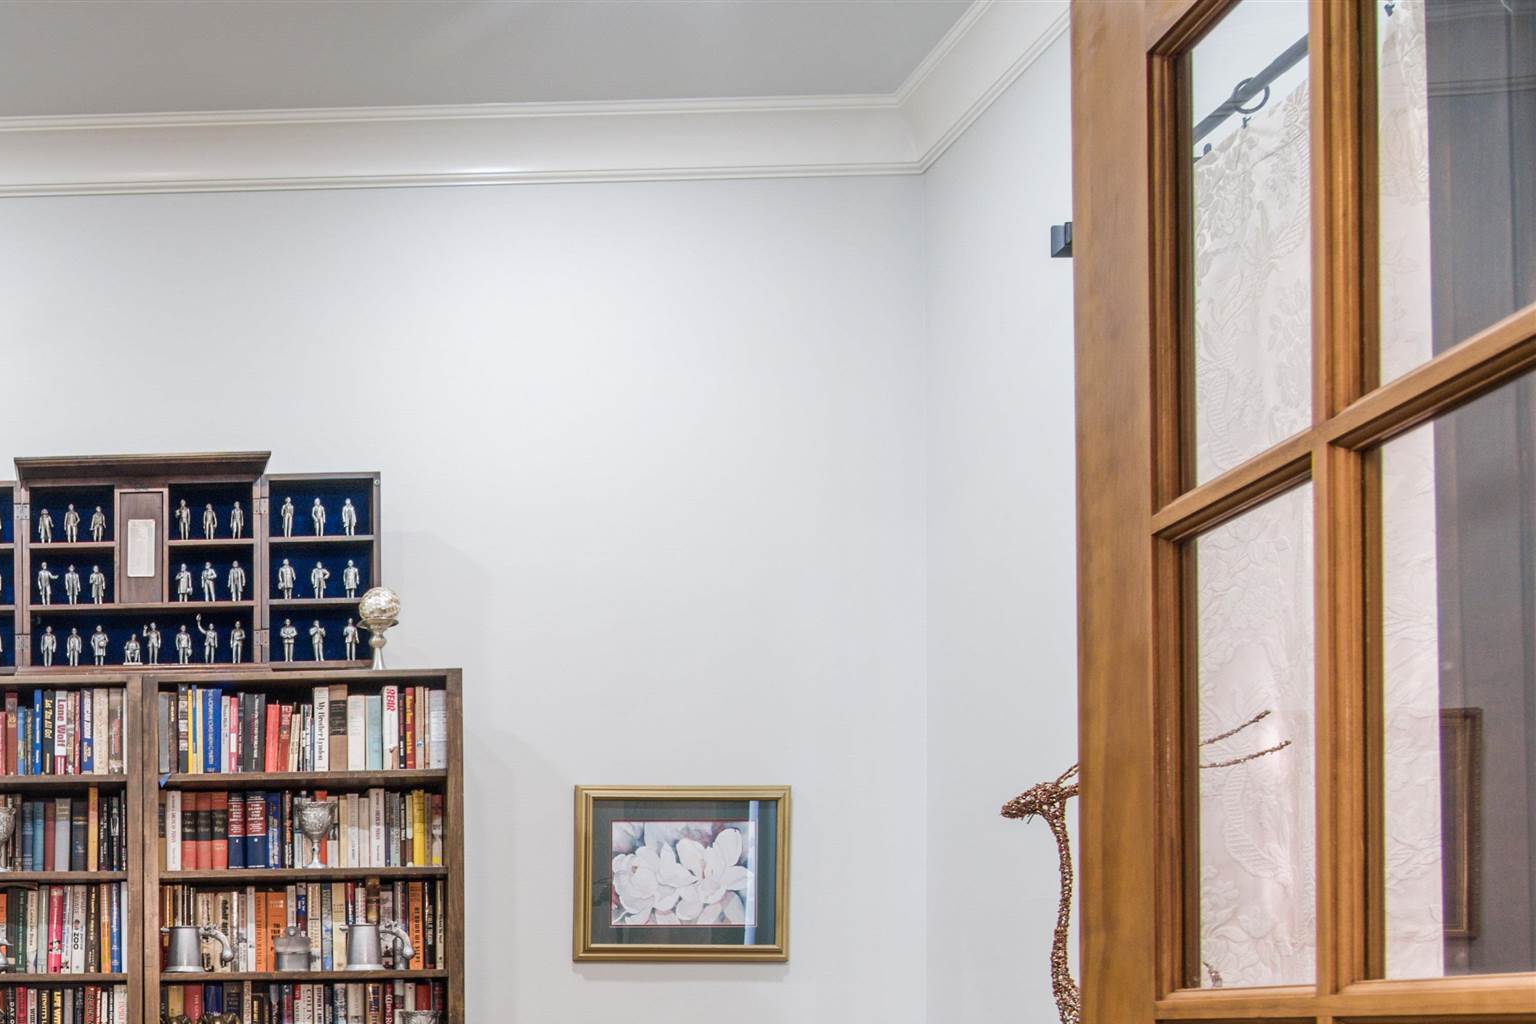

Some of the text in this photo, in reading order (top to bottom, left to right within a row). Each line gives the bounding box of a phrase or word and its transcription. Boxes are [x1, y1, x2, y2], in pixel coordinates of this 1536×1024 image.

[44, 699, 52, 708] Let
[317, 702, 325, 710] My
[57, 699, 66, 747] Lone Wolf
[317, 712, 325, 737] Brother
